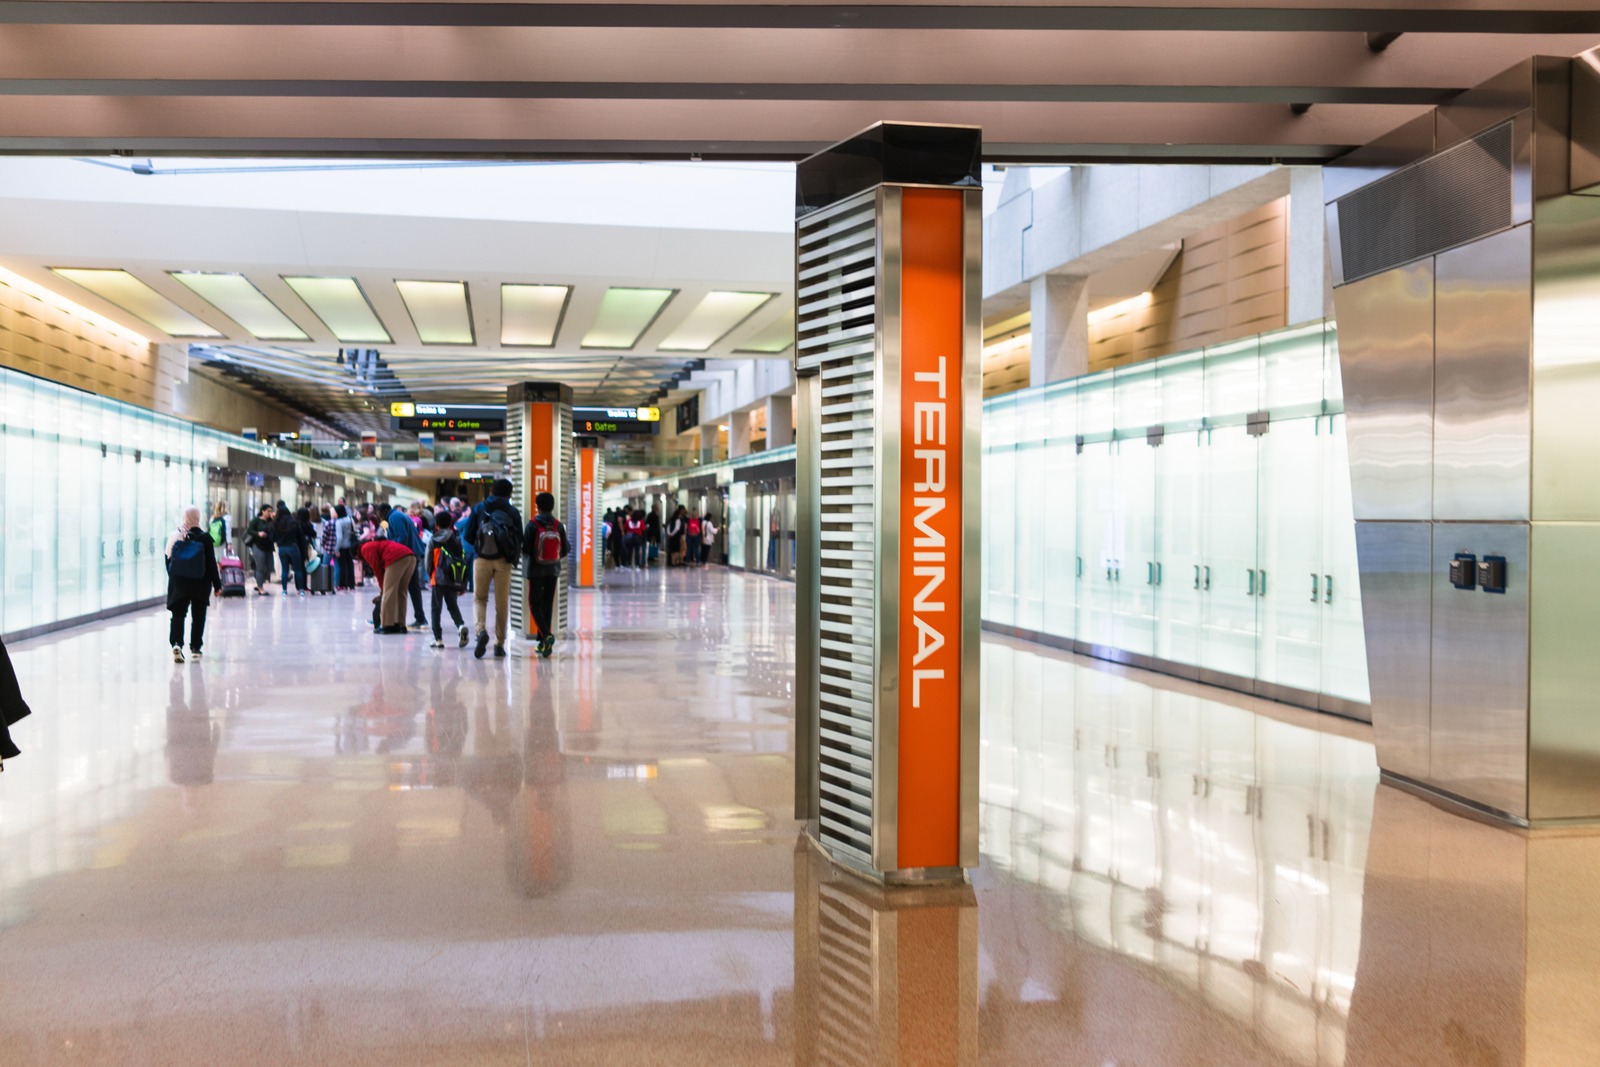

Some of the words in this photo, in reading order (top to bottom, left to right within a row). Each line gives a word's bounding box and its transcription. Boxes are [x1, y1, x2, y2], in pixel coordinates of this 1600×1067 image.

[422, 419, 429, 428] A
[448, 419, 455, 428] C
[457, 420, 480, 429] Gates
[585, 421, 593, 431] B
[582, 481, 592, 555] TERMINAL
[912, 355, 946, 708] TERMINAL
